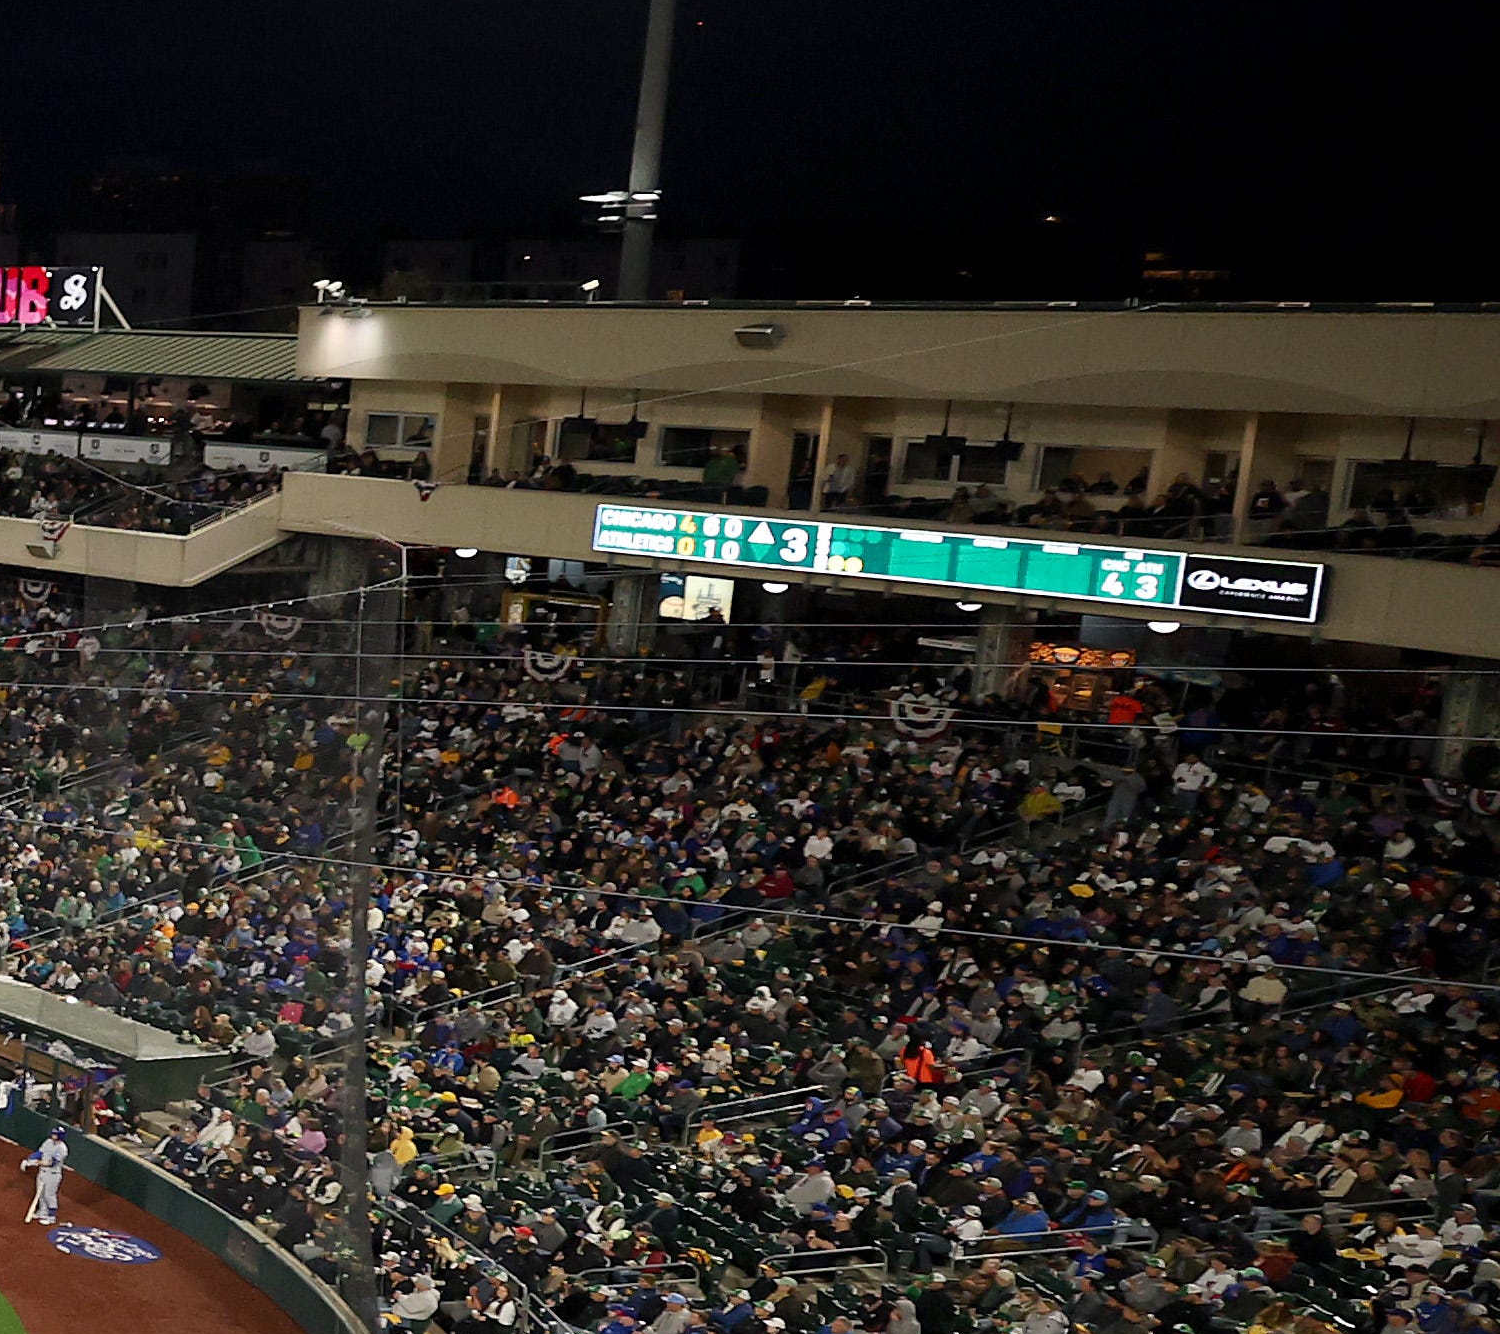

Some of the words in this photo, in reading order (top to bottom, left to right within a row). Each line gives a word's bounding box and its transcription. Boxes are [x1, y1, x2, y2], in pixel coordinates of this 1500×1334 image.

[602, 509, 676, 531] CHICAGO
[679, 515, 697, 534] 4
[724, 518, 742, 538] 0
[598, 530, 674, 552] ATHLETICS
[677, 536, 696, 556] 0
[703, 540, 716, 558] 1
[721, 540, 740, 561] 0
[779, 528, 808, 562] 3
[1100, 573, 1124, 597] 4
[1134, 575, 1158, 599] 3
[1220, 576, 1308, 595] LEXUS
